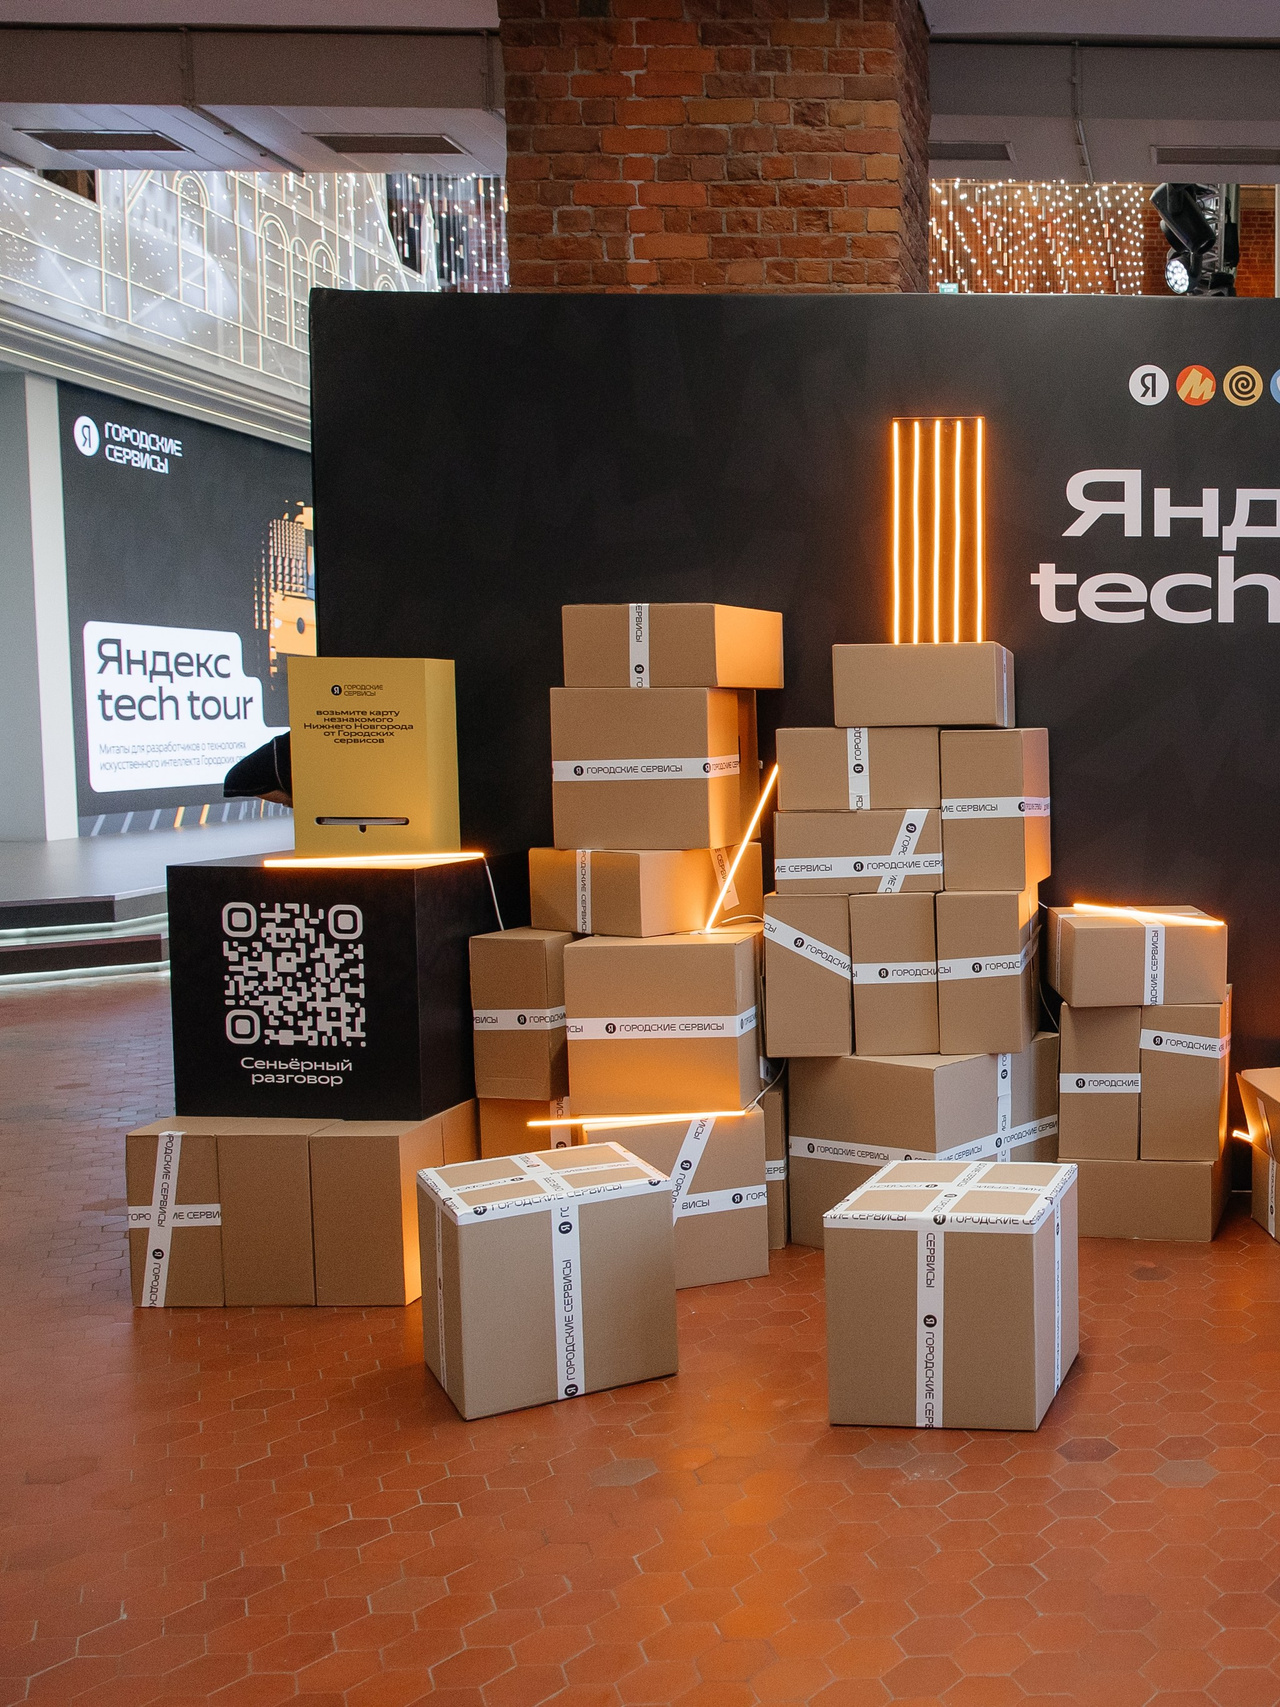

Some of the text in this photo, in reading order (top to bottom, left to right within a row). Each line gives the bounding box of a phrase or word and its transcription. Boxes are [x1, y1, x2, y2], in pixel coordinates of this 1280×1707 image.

[105, 421, 182, 457] ГОРОДСКИЕ
[105, 444, 169, 474] СЕРВИСЫ
[97, 638, 231, 683] Яндекс
[98, 686, 253, 721] tech tour
[586, 766, 639, 774] ГОРОДСКИЕ
[640, 764, 682, 773] СЕРВИСЫ
[956, 804, 998, 812] СЕРВИСЫ
[867, 860, 920, 870] ГОРОДСКИЕ
[619, 1023, 676, 1032] ГОРОДСКИЕ
[678, 1022, 724, 1031] СЕРВИСЫ
[1166, 1038, 1217, 1052] ГОРОДСКИЕ
[240, 1057, 352, 1072] Сеньёрный
[251, 1073, 343, 1086] разговор
[1088, 1080, 1140, 1088] ГОРОДСКИЕ
[1004, 1121, 1058, 1144] ГОРОДСКИЕ СЕРВИ
[816, 1145, 890, 1160] ГОРОДСКИЕ СЕРВИСЫ
[955, 1145, 982, 1160] СЕРВИСЫ
[157, 1181, 169, 1227] СЕРВИСЫ
[187, 1211, 221, 1220] СЕРВИ
[926, 1233, 936, 1288] СЕРВИСЫ
[564, 1259, 572, 1314] СЕРВИСЫ
[566, 1315, 576, 1380] ГОРОДСКИЕ
[924, 1332, 935, 1400] ГОРОДСКИЕ
